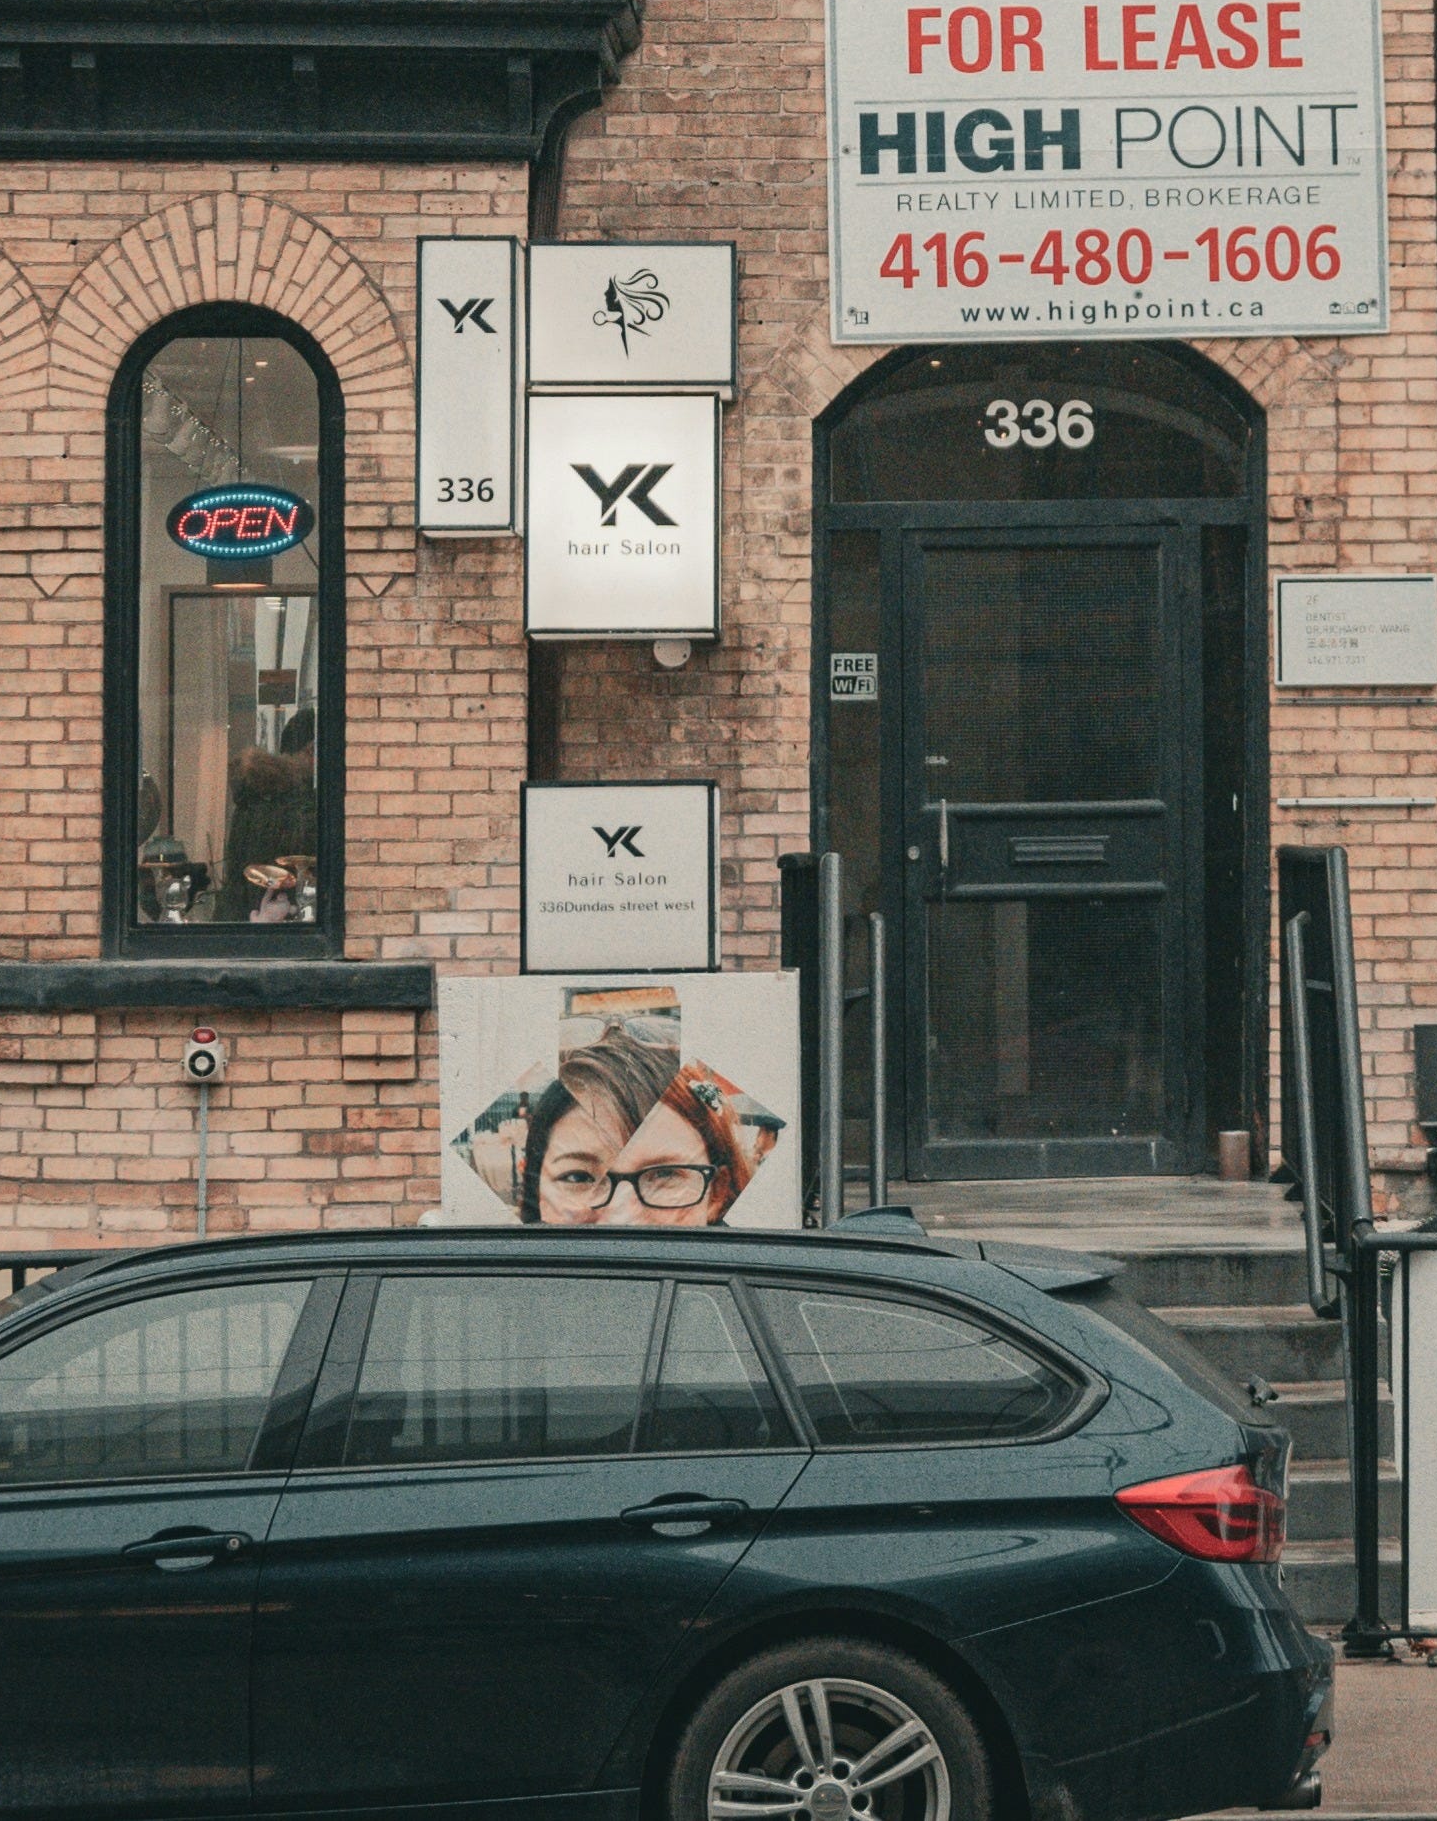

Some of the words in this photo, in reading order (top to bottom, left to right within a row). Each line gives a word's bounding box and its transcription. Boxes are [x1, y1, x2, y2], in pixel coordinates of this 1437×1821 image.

[907, 6, 1044, 74] FOR
[1083, 2, 1303, 71] LEASE
[859, 107, 1082, 175] HIGH
[1115, 104, 1358, 169] POINT
[896, 192, 999, 212] REALTY
[1014, 189, 1136, 211] LIMITED,
[1145, 186, 1322, 208] BROKERAGE
[880, 224, 1342, 289] 416-480-1606
[960, 297, 1265, 325] www.highpoint.ca
[983, 399, 1095, 449] 336
[436, 477, 495, 503] 336
[176, 504, 299, 542] OPEN
[568, 539, 609, 556] hair
[620, 538, 682, 556] Salon
[833, 658, 874, 672] FREE
[568, 873, 604, 887] hair
[614, 872, 668, 887] Salon
[619, 900, 660, 913] street
[664, 899, 696, 912] west
